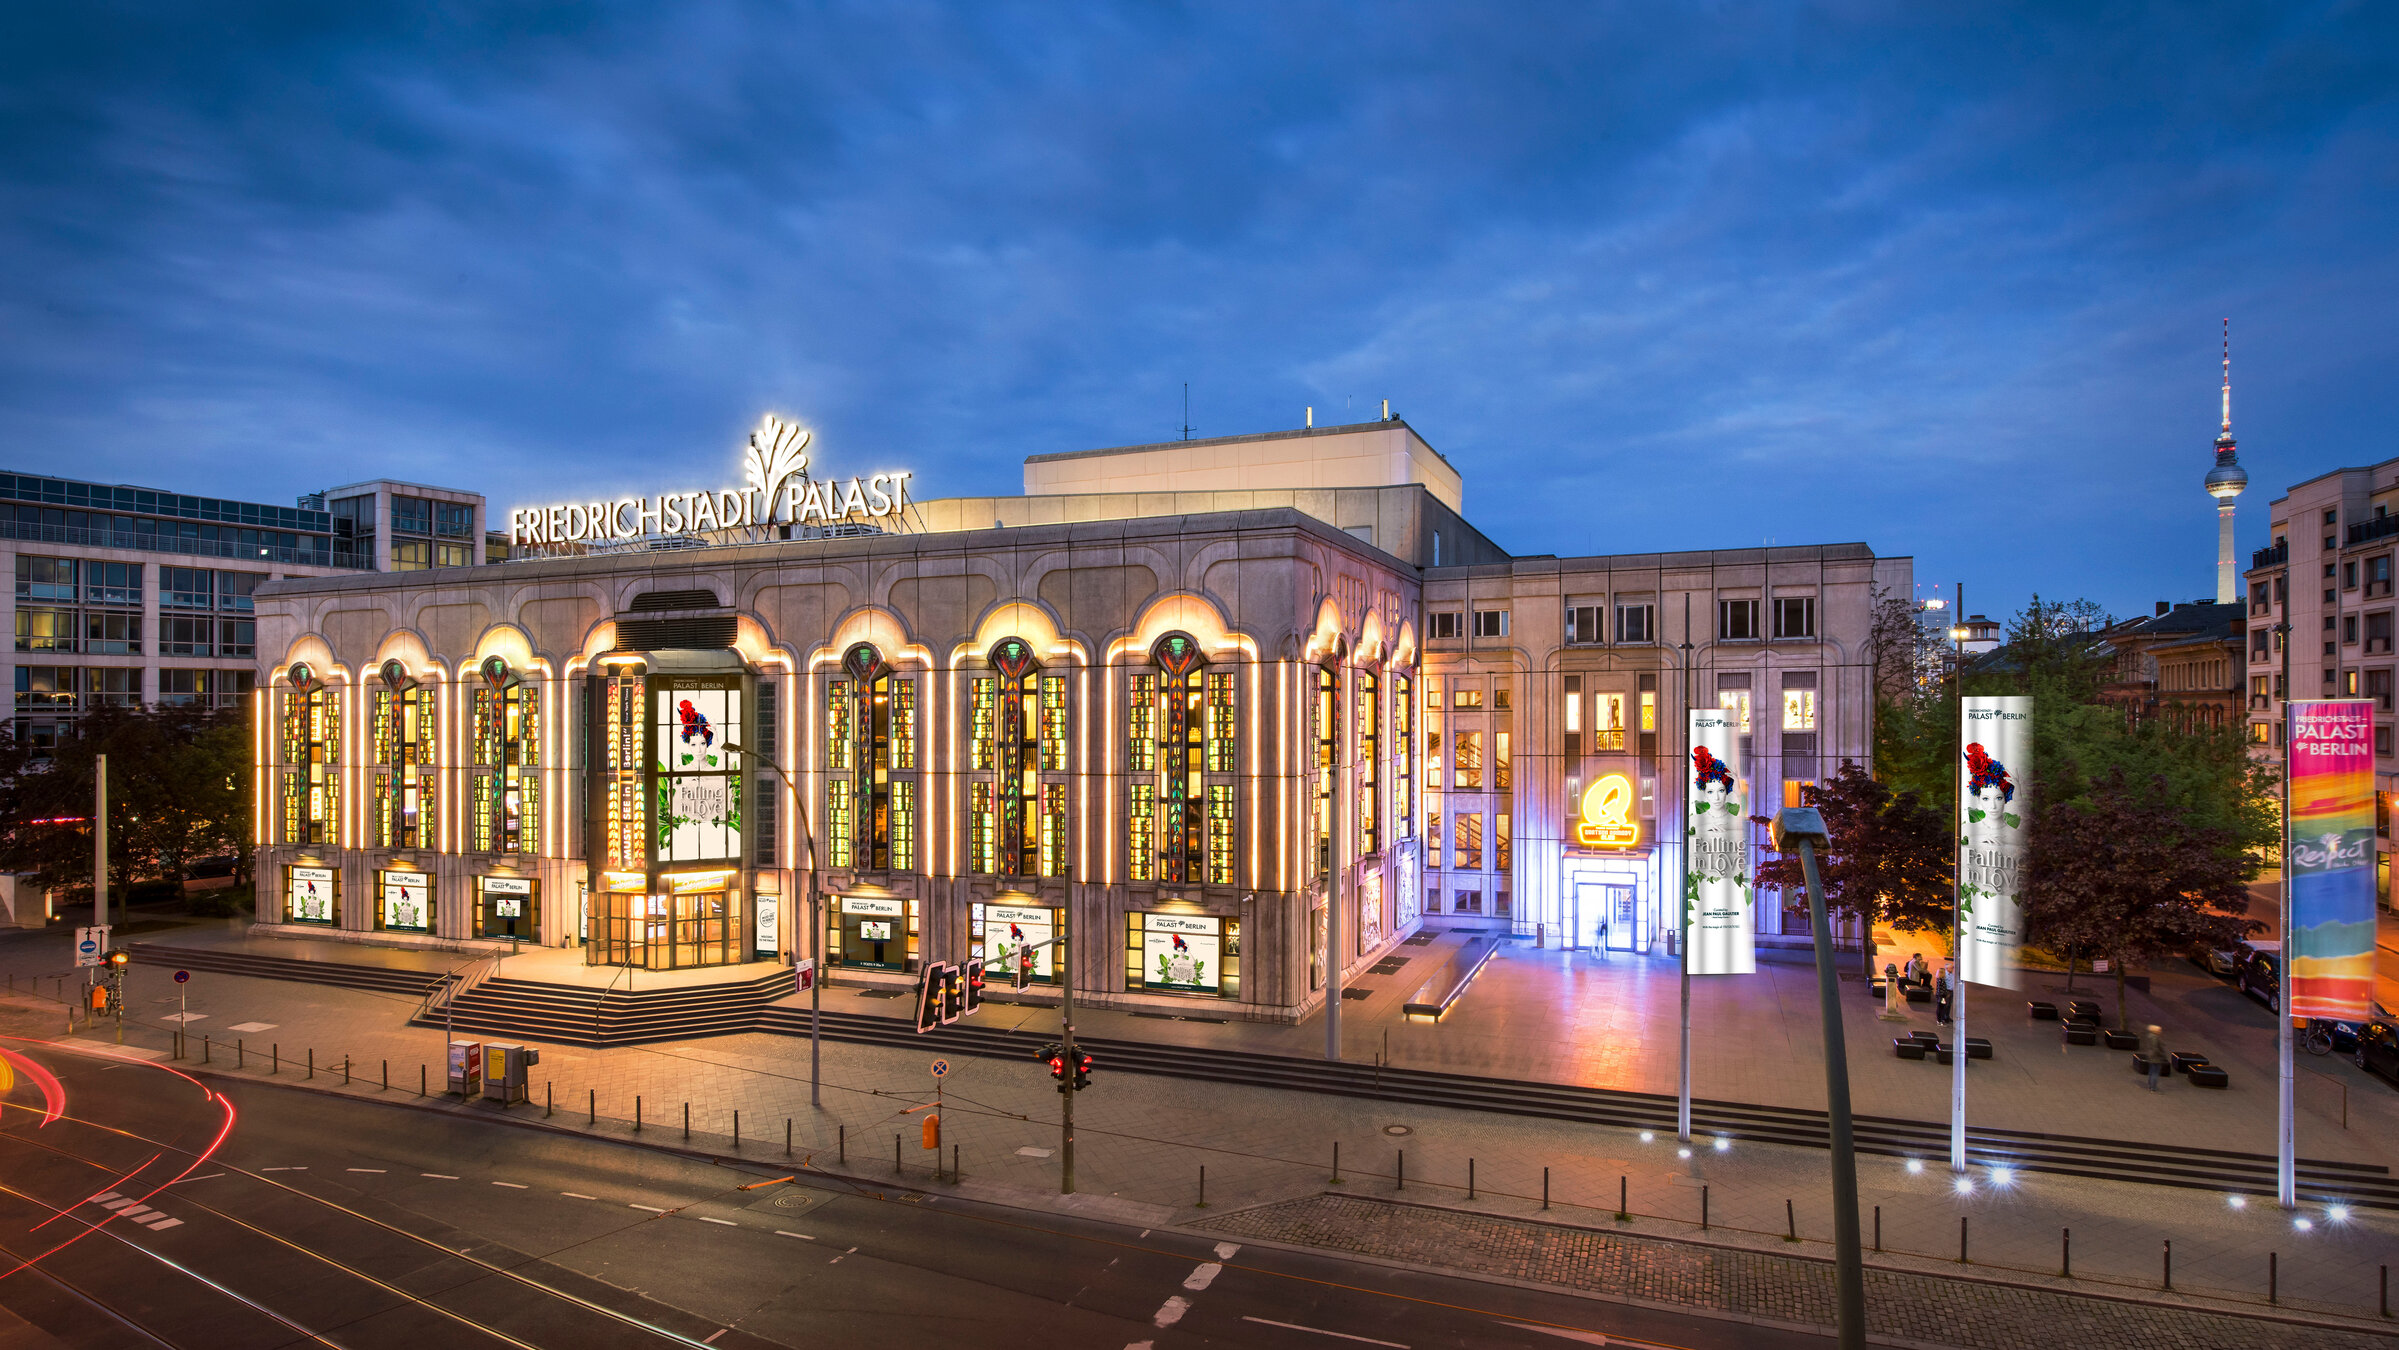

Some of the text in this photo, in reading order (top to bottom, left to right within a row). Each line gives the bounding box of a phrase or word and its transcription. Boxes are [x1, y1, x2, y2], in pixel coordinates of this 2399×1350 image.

[512, 473, 912, 545] FRIEDRICHSTADT PALAST
[2296, 724, 2368, 739] PALAST
[2310, 742, 2368, 755] BERLIN
[623, 786, 631, 797] in
[681, 786, 722, 804] Falling
[1583, 774, 1632, 824] Q
[682, 800, 722, 818] in Love
[1693, 836, 1746, 856] Falling
[2292, 838, 2372, 869] Respect
[1694, 853, 1746, 877] in Love
[1968, 867, 2023, 894] in Love
